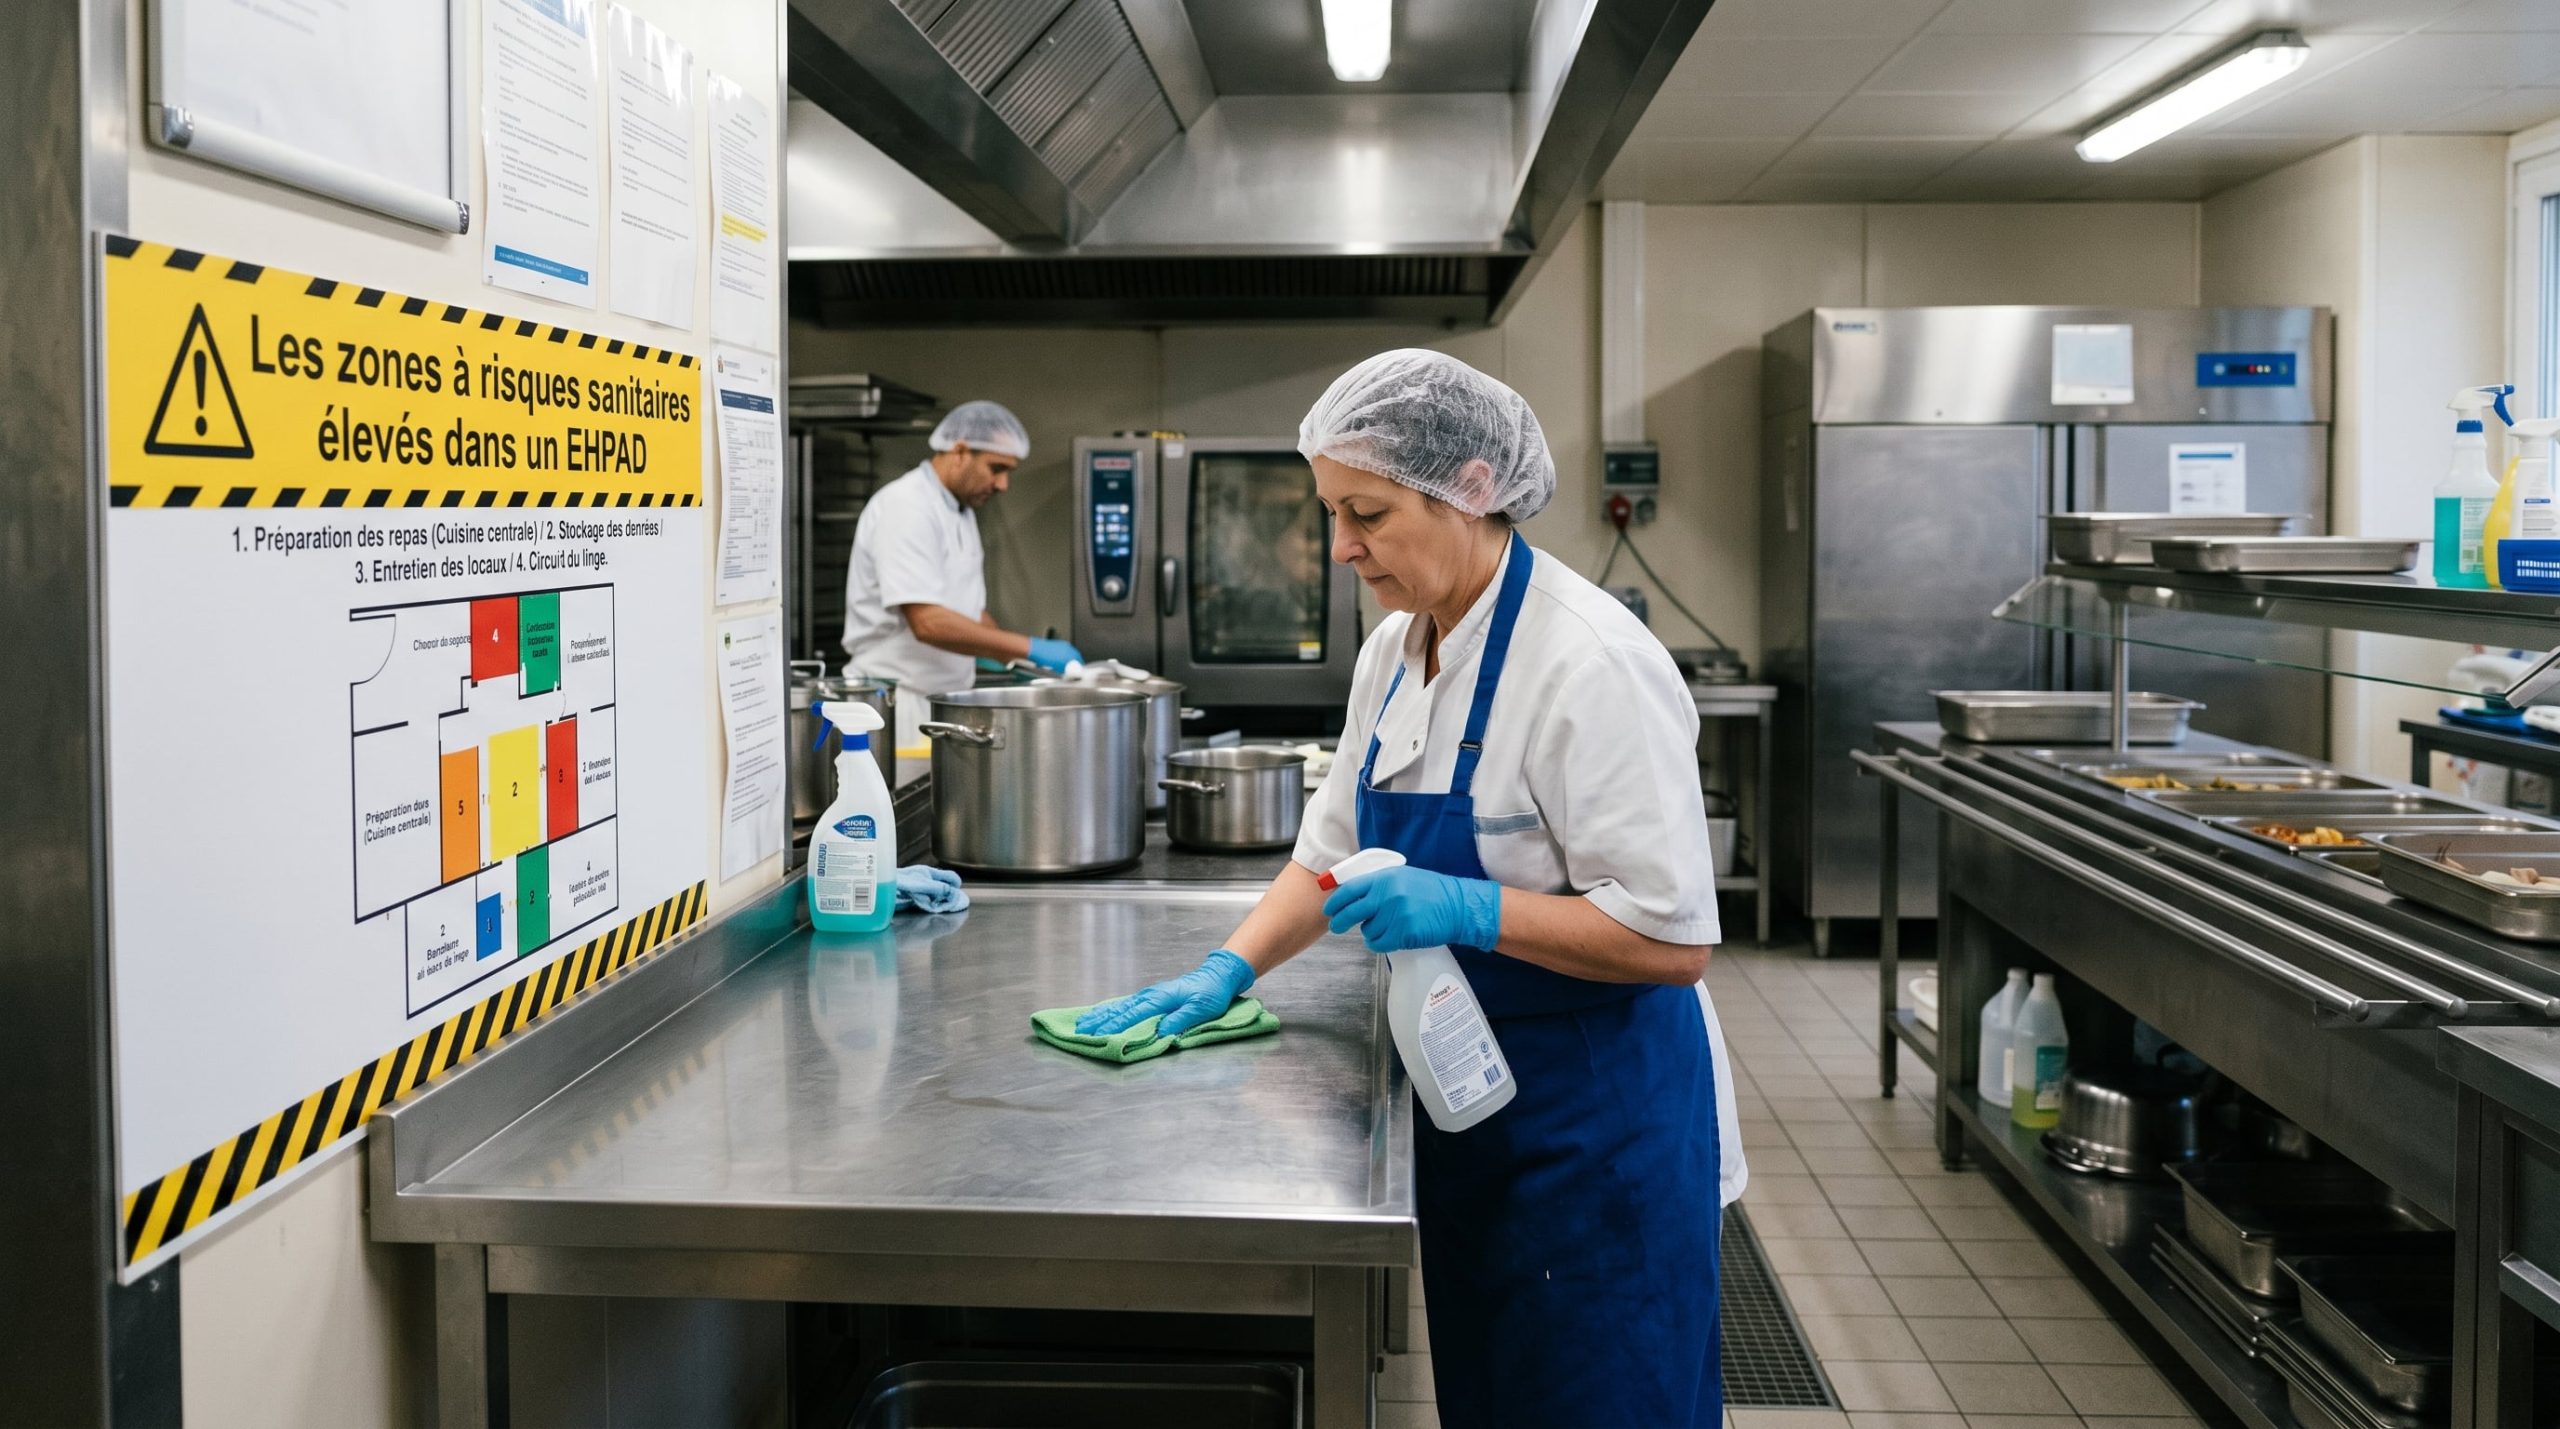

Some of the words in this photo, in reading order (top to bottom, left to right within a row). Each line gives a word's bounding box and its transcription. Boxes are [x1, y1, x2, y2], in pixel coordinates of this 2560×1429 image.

[251, 314, 324, 380] Les
[337, 341, 442, 394] zones
[453, 345, 470, 397] à
[481, 352, 580, 416] risques
[588, 375, 690, 423] sanitaires
[318, 404, 433, 465] élevés
[445, 417, 516, 469] dans
[527, 435, 558, 470] un
[567, 427, 647, 474] EHPAD
[232, 526, 248, 552] 1.
[254, 525, 352, 556] Préparation
[357, 524, 384, 547] des
[389, 527, 428, 551] repas
[431, 522, 484, 549] (Cuisine
[487, 520, 538, 545] centrale)
[546, 520, 556, 540] 2.
[559, 520, 604, 543] Stockage
[606, 519, 623, 537] des
[625, 518, 659, 537] denrées
[355, 560, 368, 584] 3.
[373, 557, 437, 582] Entretien
[441, 555, 464, 577] des
[468, 554, 507, 575] locaux
[516, 553, 526, 572] 4.
[567, 549, 580, 568] du
[582, 548, 608, 570] linge.
[512, 781, 519, 797] 2
[458, 800, 464, 816] 5
